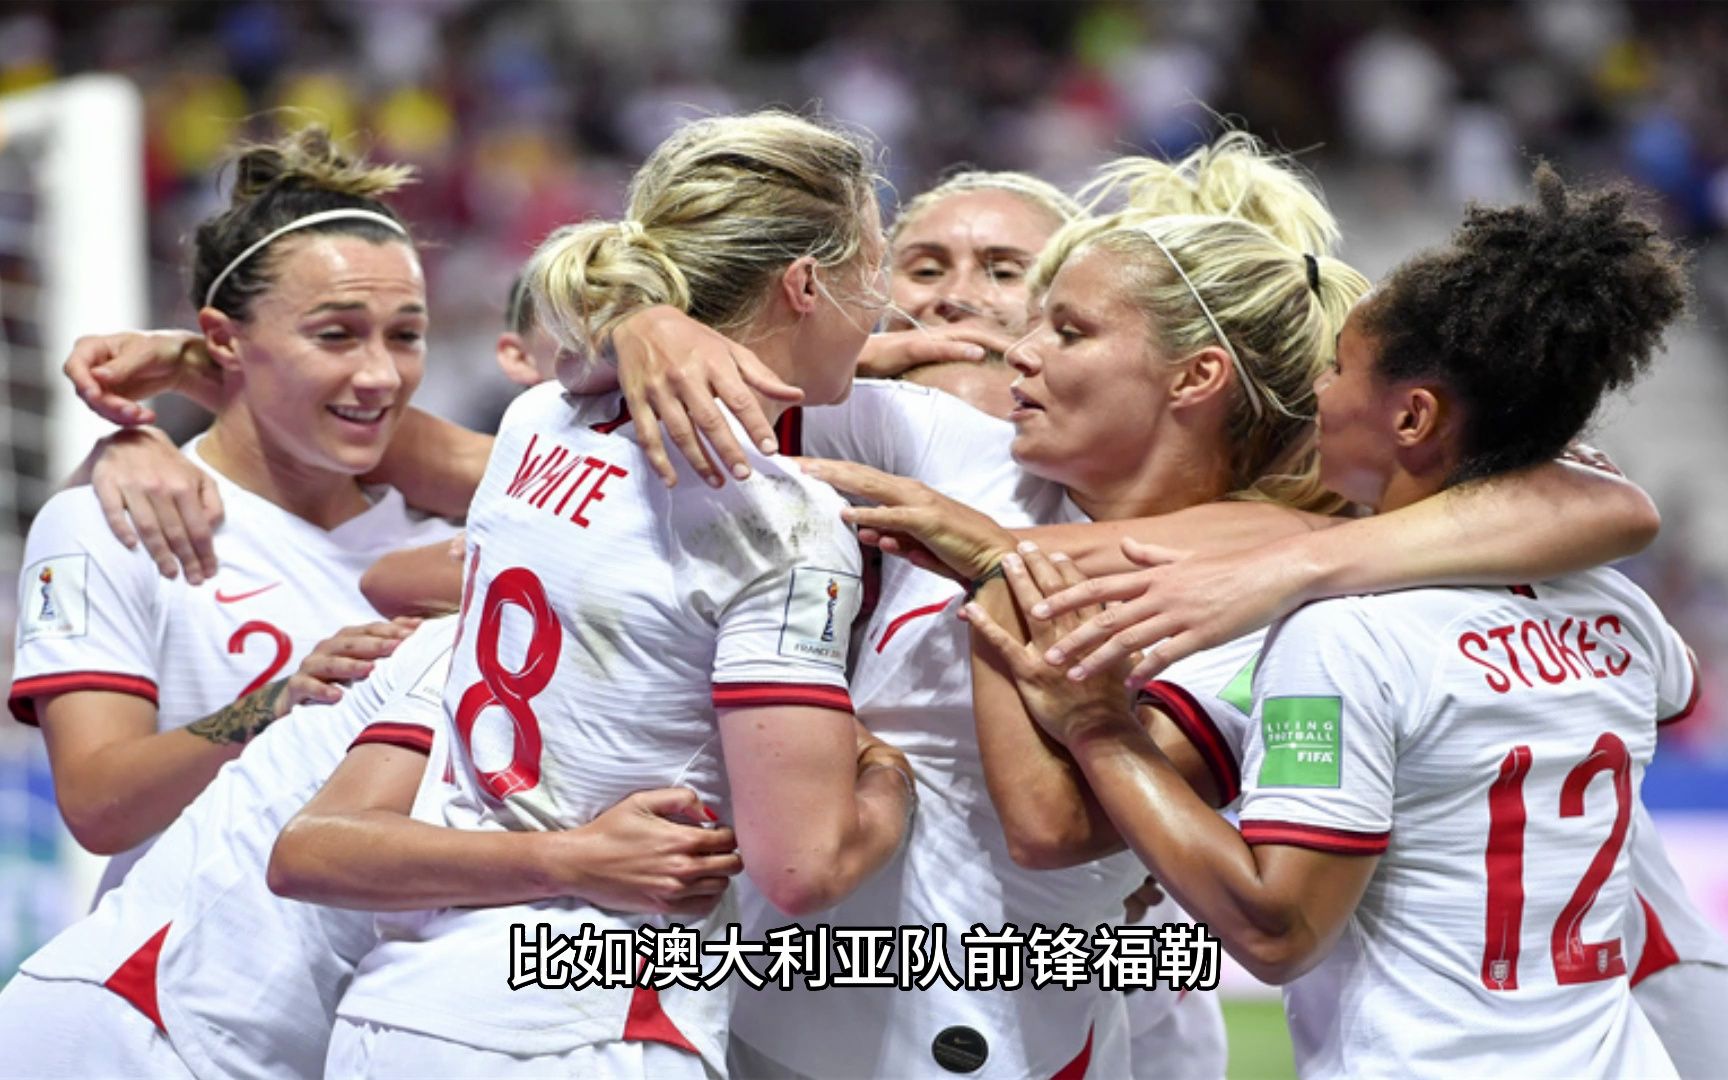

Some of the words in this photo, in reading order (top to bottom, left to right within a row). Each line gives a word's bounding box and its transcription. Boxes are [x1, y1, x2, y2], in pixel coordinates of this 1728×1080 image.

[505, 432, 629, 529] WHITE
[227, 619, 293, 701] 2
[1457, 614, 1633, 694] STOKES
[1297, 751, 1334, 764] FIFA
[1480, 731, 1633, 992] 12
